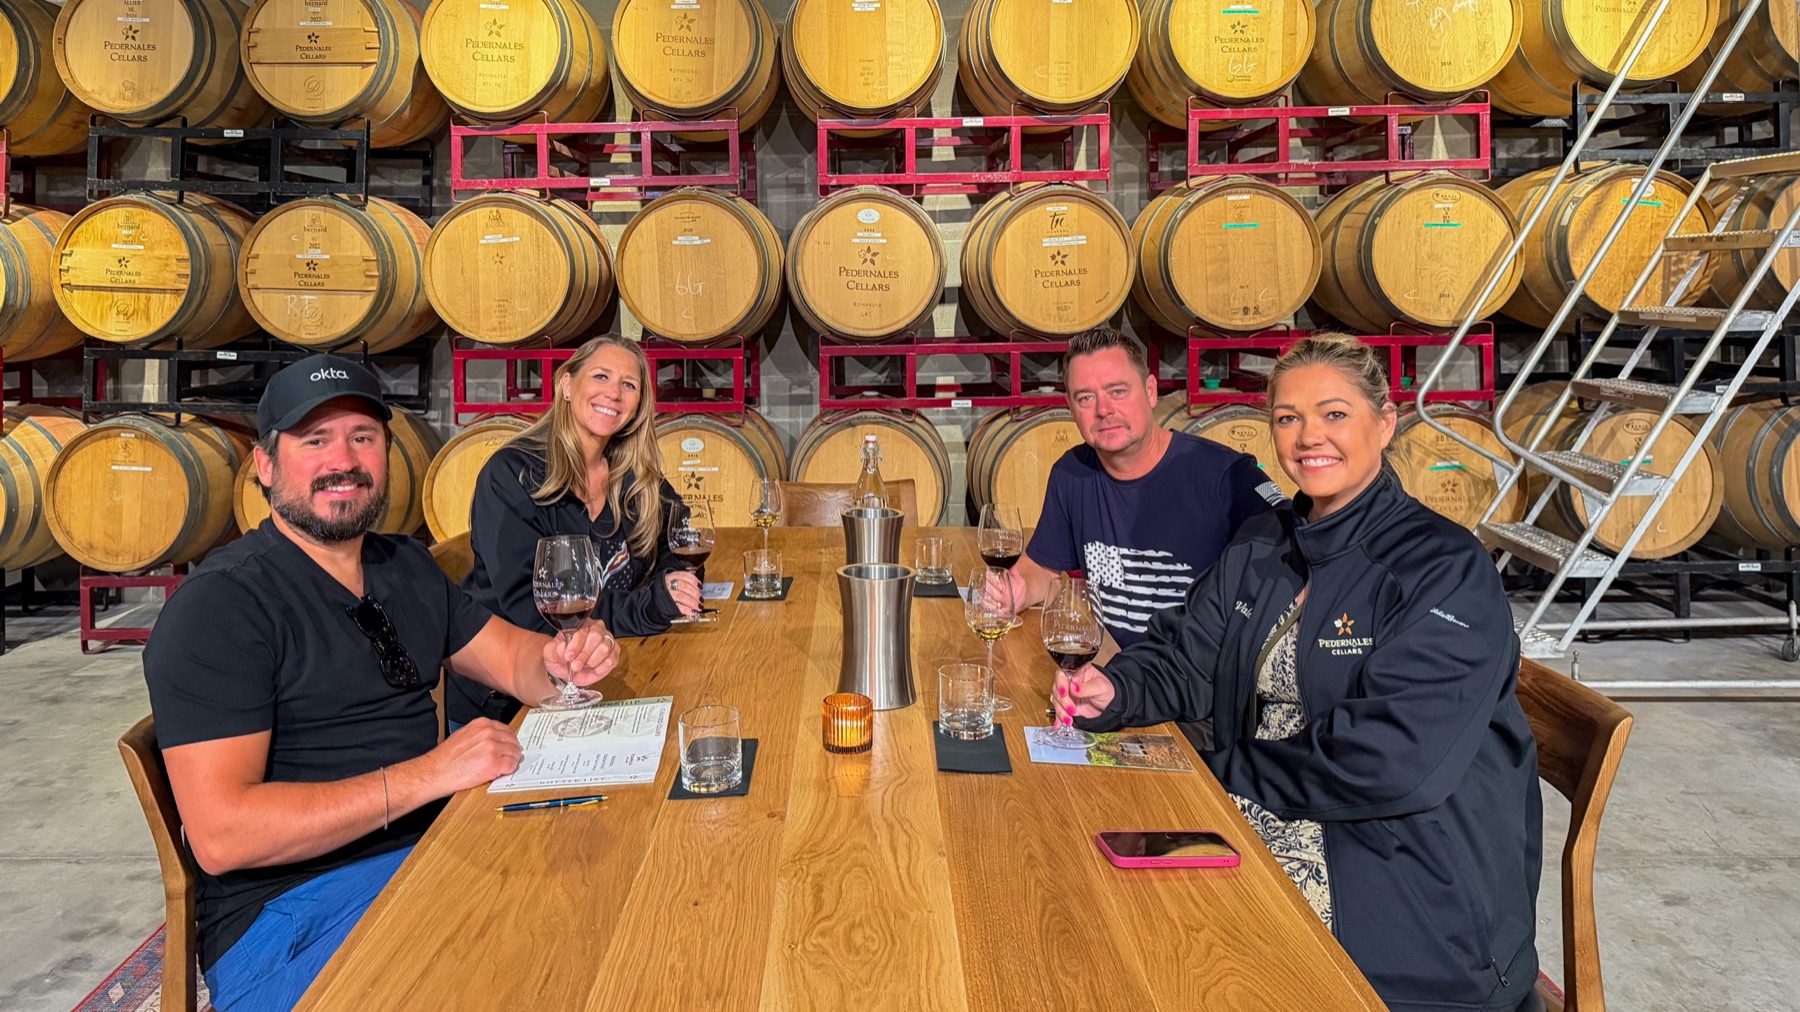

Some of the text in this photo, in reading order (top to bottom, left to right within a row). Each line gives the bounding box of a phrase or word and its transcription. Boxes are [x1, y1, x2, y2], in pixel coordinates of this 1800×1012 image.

[465, 38, 525, 51] PEDERNALES
[656, 32, 715, 46] PEDERNALES
[1214, 36, 1265, 44] PEDERNALES
[104, 40, 157, 51] PEDERNALES
[295, 44, 332, 52] PEDERNALES
[1220, 45, 1258, 53] CELLARS
[110, 52, 148, 62] CELLARS
[300, 52, 327, 60] CELLARS
[472, 51, 516, 63] CELLARS
[662, 46, 706, 58] CELLARS
[117, 222, 141, 230] bernard
[105, 268, 142, 276] PEDERNALES
[838, 266, 900, 279] PEDERNALES
[1034, 267, 1088, 278] PEDERNALES
[846, 280, 890, 292] CELLARS
[1042, 279, 1081, 289] CELLARS
[310, 367, 350, 382] okta
[1317, 637, 1374, 648] PEDERNALES
[1331, 647, 1363, 656] CELLARS
